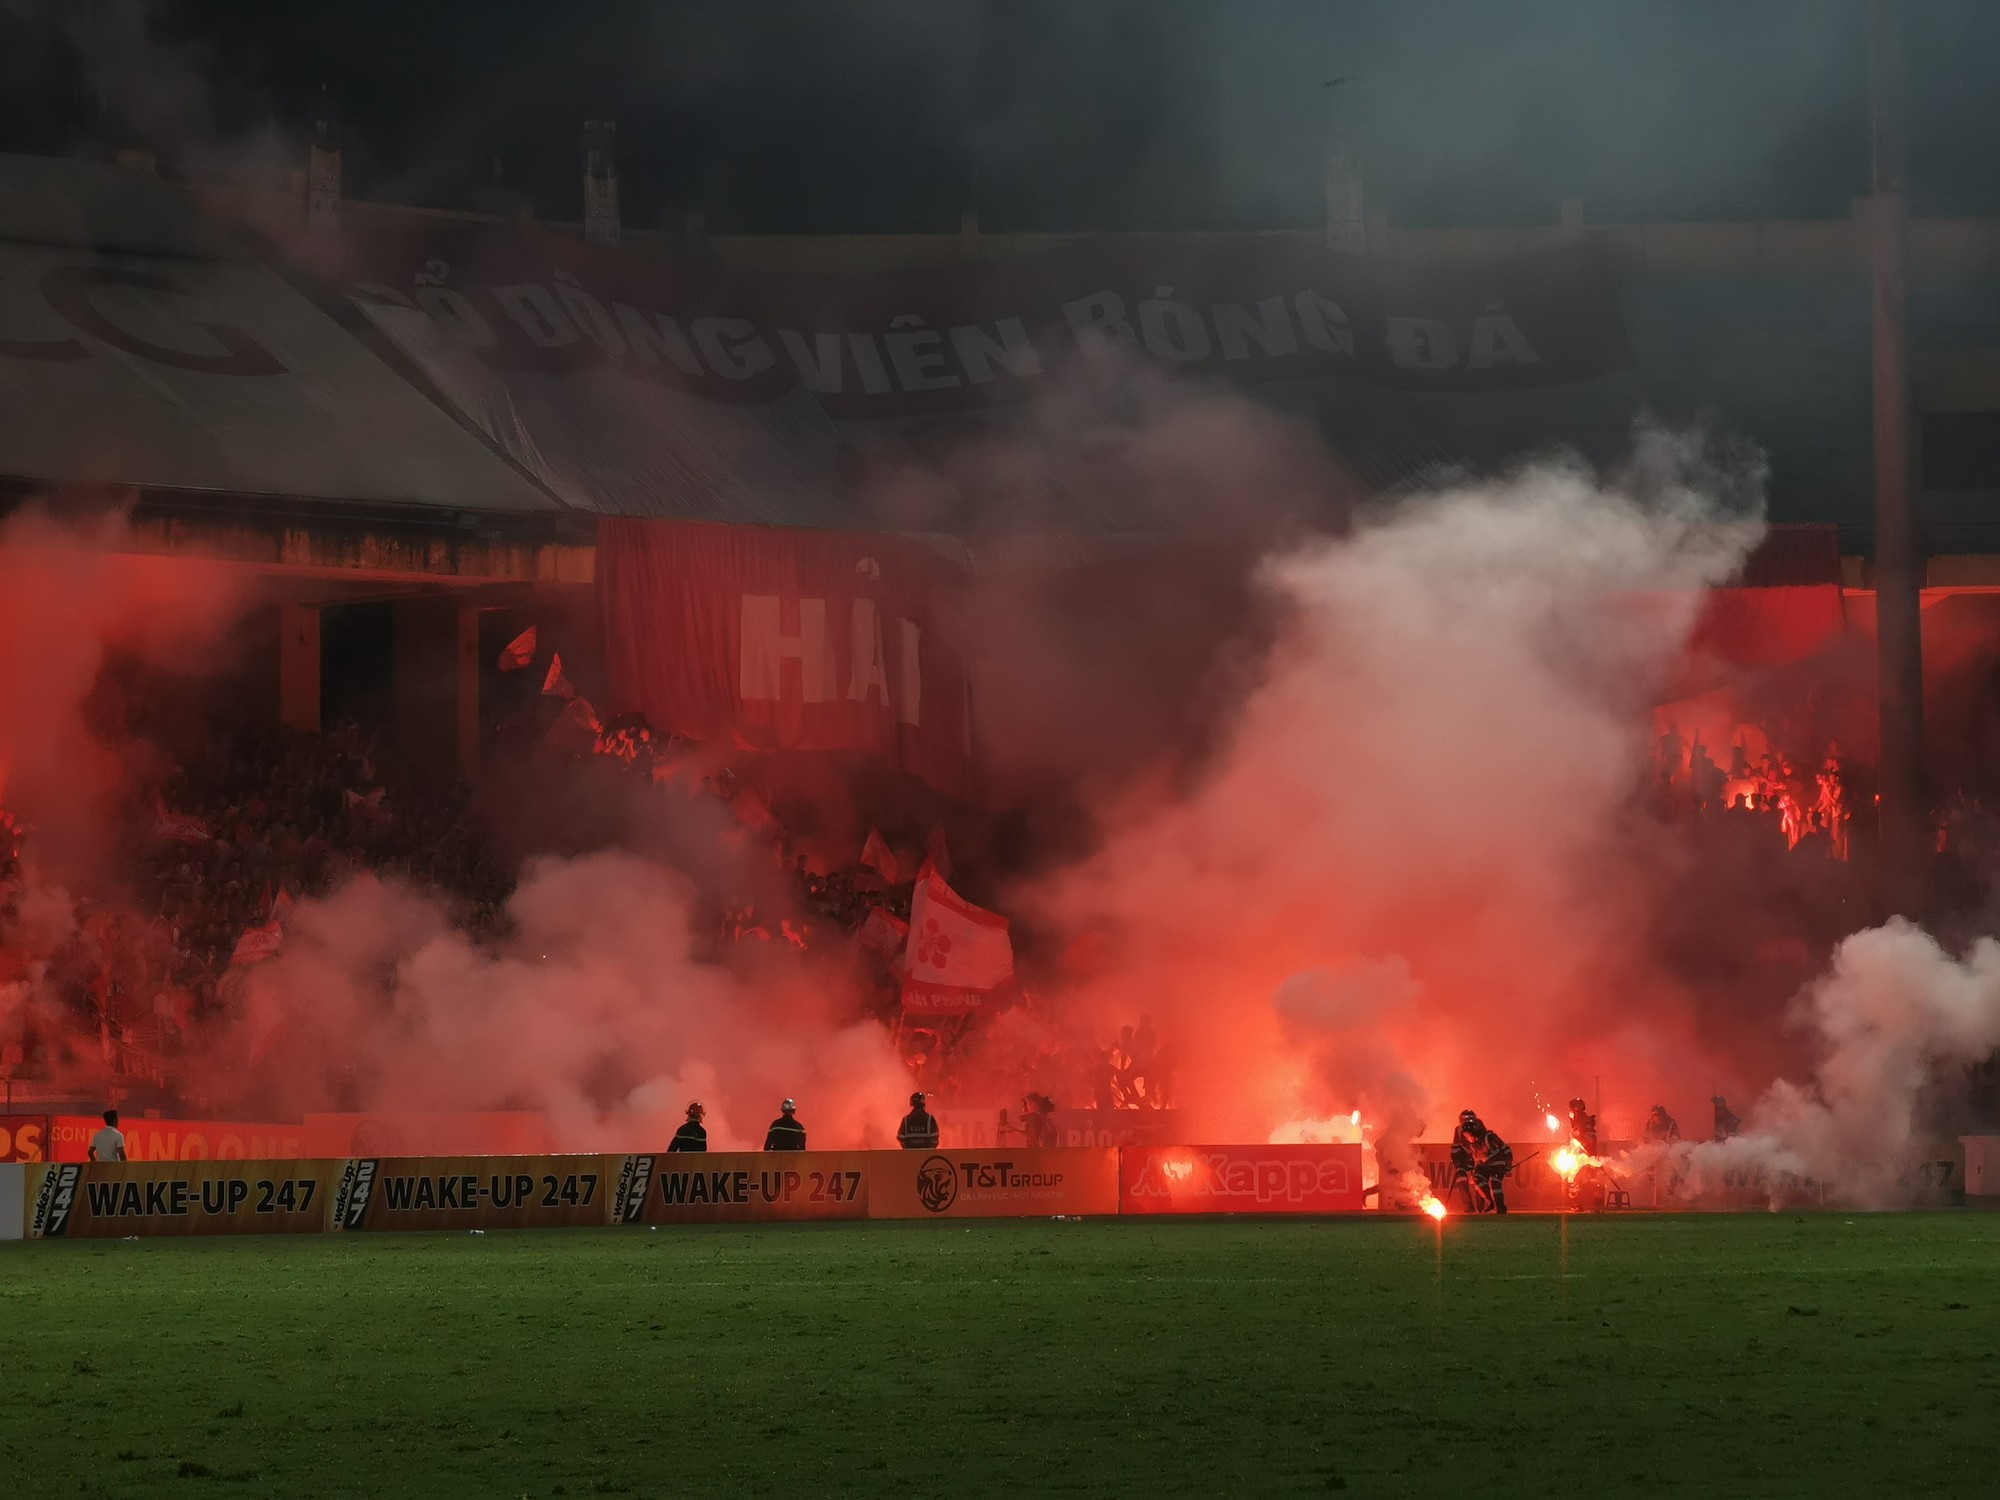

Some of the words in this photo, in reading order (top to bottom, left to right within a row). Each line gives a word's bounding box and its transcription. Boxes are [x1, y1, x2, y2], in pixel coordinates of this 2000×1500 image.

[777, 314, 1044, 394] VIÊN
[1062, 286, 1354, 362] BÓNG
[1386, 302, 1543, 369] ĐÁ
[52, 1126, 86, 1142] SON
[33, 1171, 58, 1229] wake-up
[50, 1167, 78, 1232] 247
[87, 1180, 248, 1217] WAKE-UP
[256, 1179, 317, 1213] 247
[333, 1166, 356, 1223] wake-up
[348, 1162, 375, 1225] 247
[384, 1175, 534, 1210] WAKE-UP
[541, 1174, 599, 1207] 247
[613, 1161, 634, 1216] wake-up
[628, 1157, 652, 1219] 247
[660, 1170, 801, 1206] WAKE-UP
[808, 1171, 861, 1202] 247
[960, 1163, 1013, 1188] T&T
[1011, 1174, 1064, 1187] GROUP
[1194, 1154, 1349, 1203] Kappa
